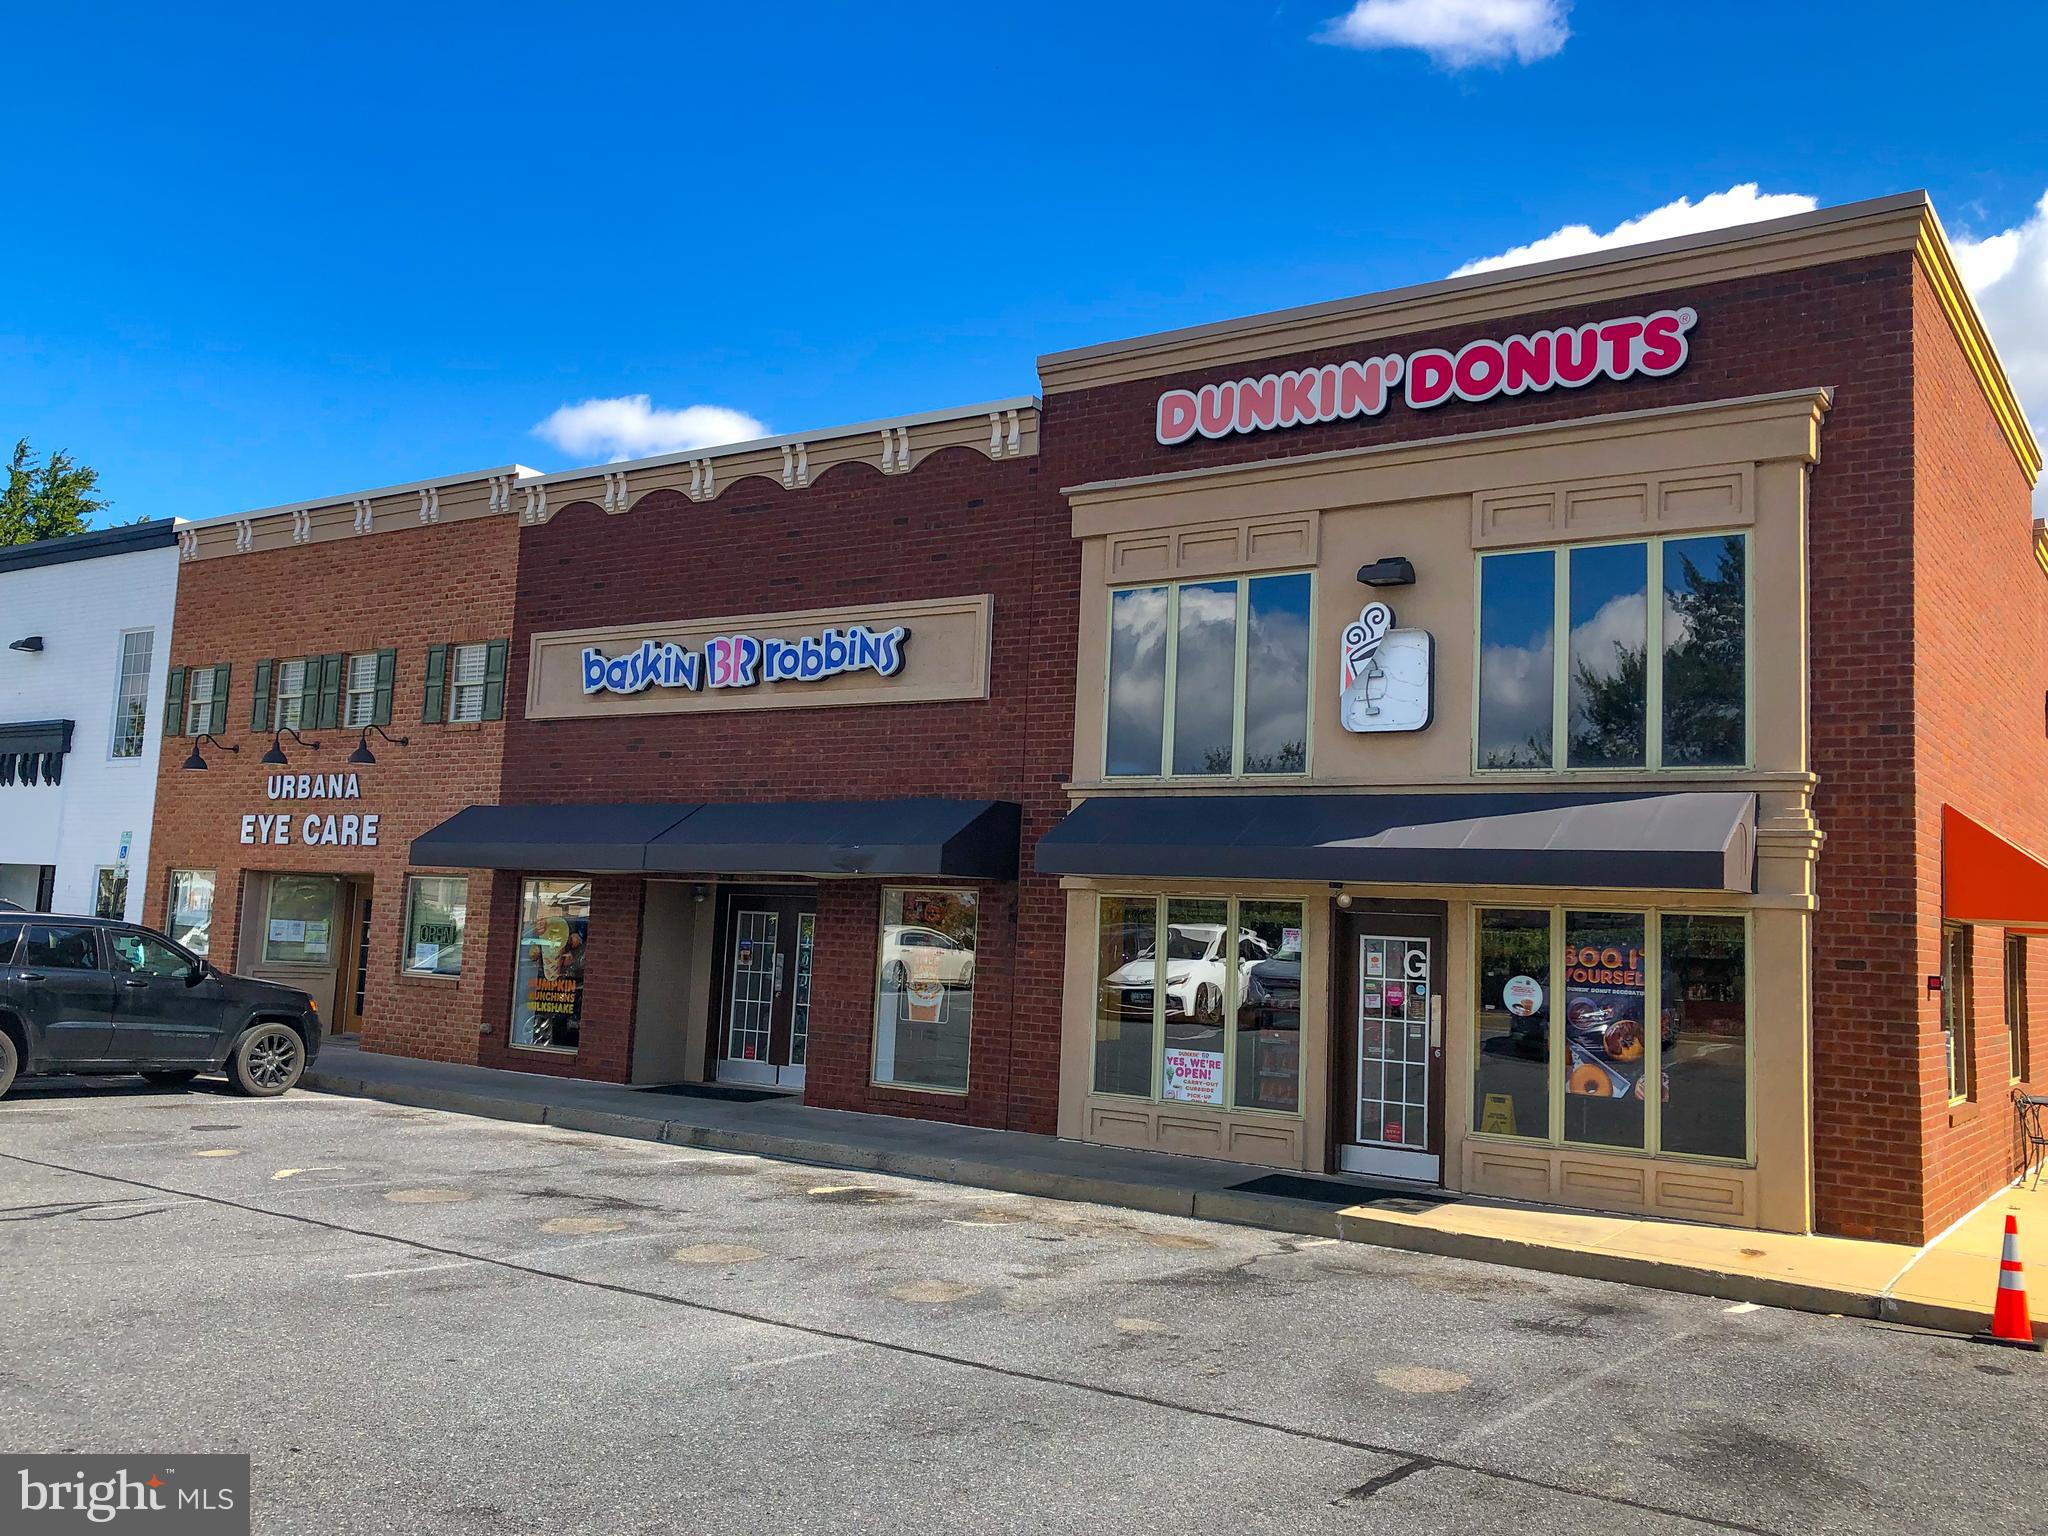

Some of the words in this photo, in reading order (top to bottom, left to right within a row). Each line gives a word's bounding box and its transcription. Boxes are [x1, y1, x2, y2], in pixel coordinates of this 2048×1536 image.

[1158, 356, 1401, 442] DUNKIN'
[1408, 314, 1684, 406] DONUTS
[583, 642, 697, 690] baskin
[706, 637, 757, 686] BR
[764, 627, 896, 678] robbins
[267, 773, 360, 800] URBANA
[240, 814, 291, 844] EYE
[302, 814, 379, 846] CARE
[1403, 949, 1427, 978] G
[528, 977, 576, 992] UMPKIN
[527, 1001, 574, 1014] ILKSHAKE
[1167, 1056, 1187, 1067] YES,
[1190, 1058, 1221, 1069] WE'RE
[1175, 1067, 1211, 1080] OPEN!
[1183, 1079, 1218, 1087] CARRY-OUT
